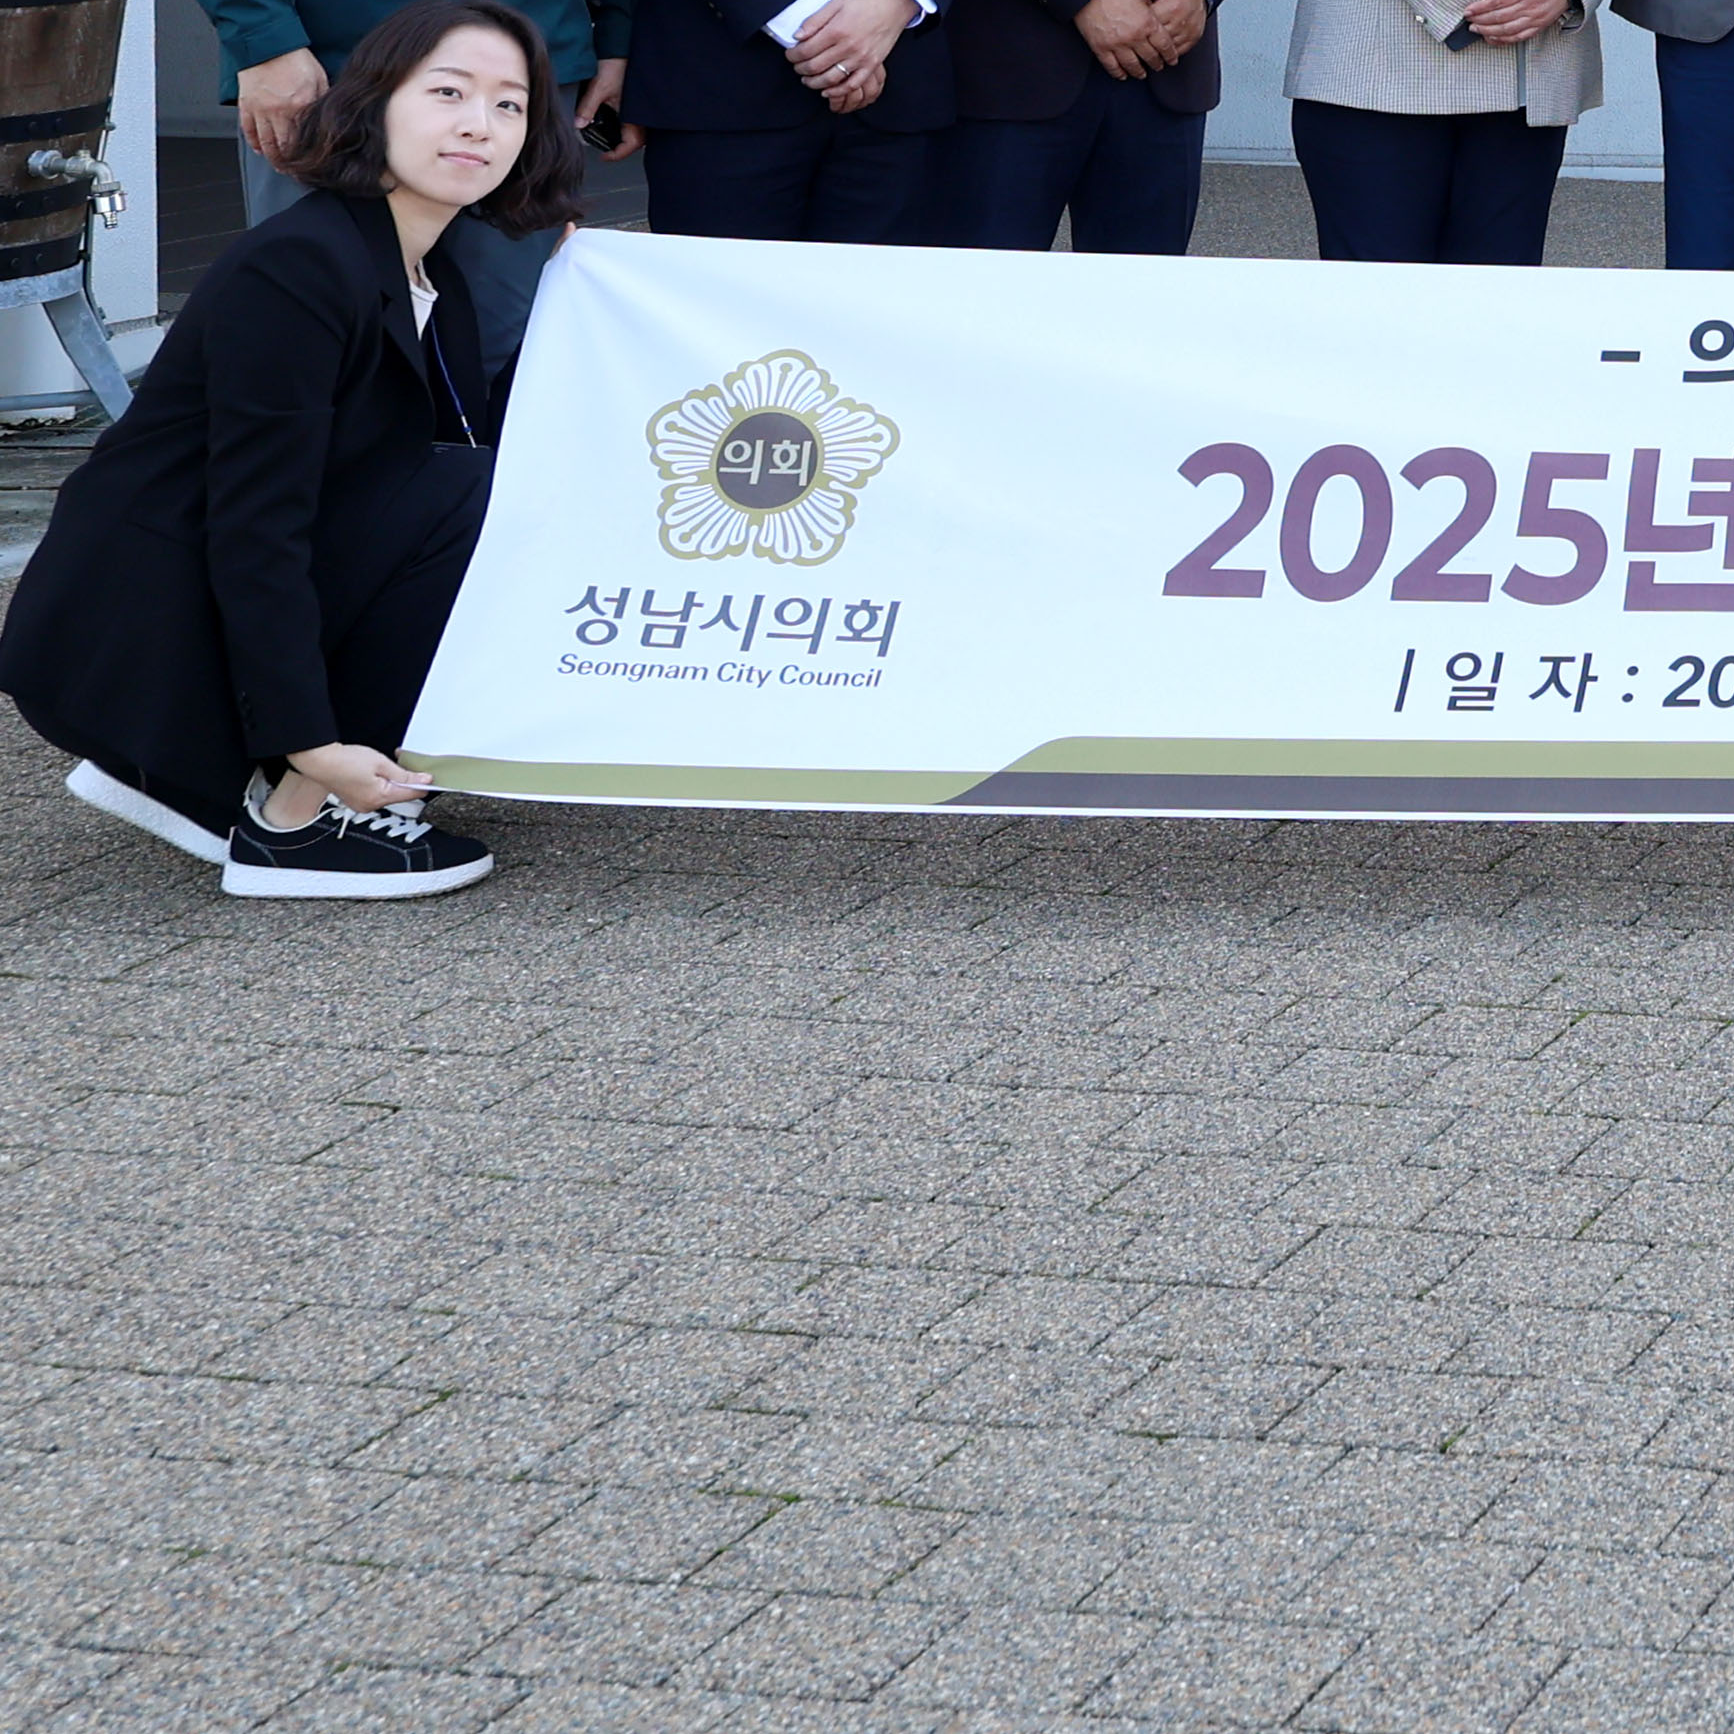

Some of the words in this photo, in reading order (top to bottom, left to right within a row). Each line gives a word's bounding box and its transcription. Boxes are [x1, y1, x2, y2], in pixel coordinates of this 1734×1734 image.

[719, 439, 813, 486] 의회
[563, 585, 902, 658] 성남시의회
[556, 653, 708, 682] Seongnam
[716, 661, 772, 689] City
[779, 665, 883, 688] Council
[1446, 651, 1505, 712] 일
[1528, 652, 1599, 713] 자
